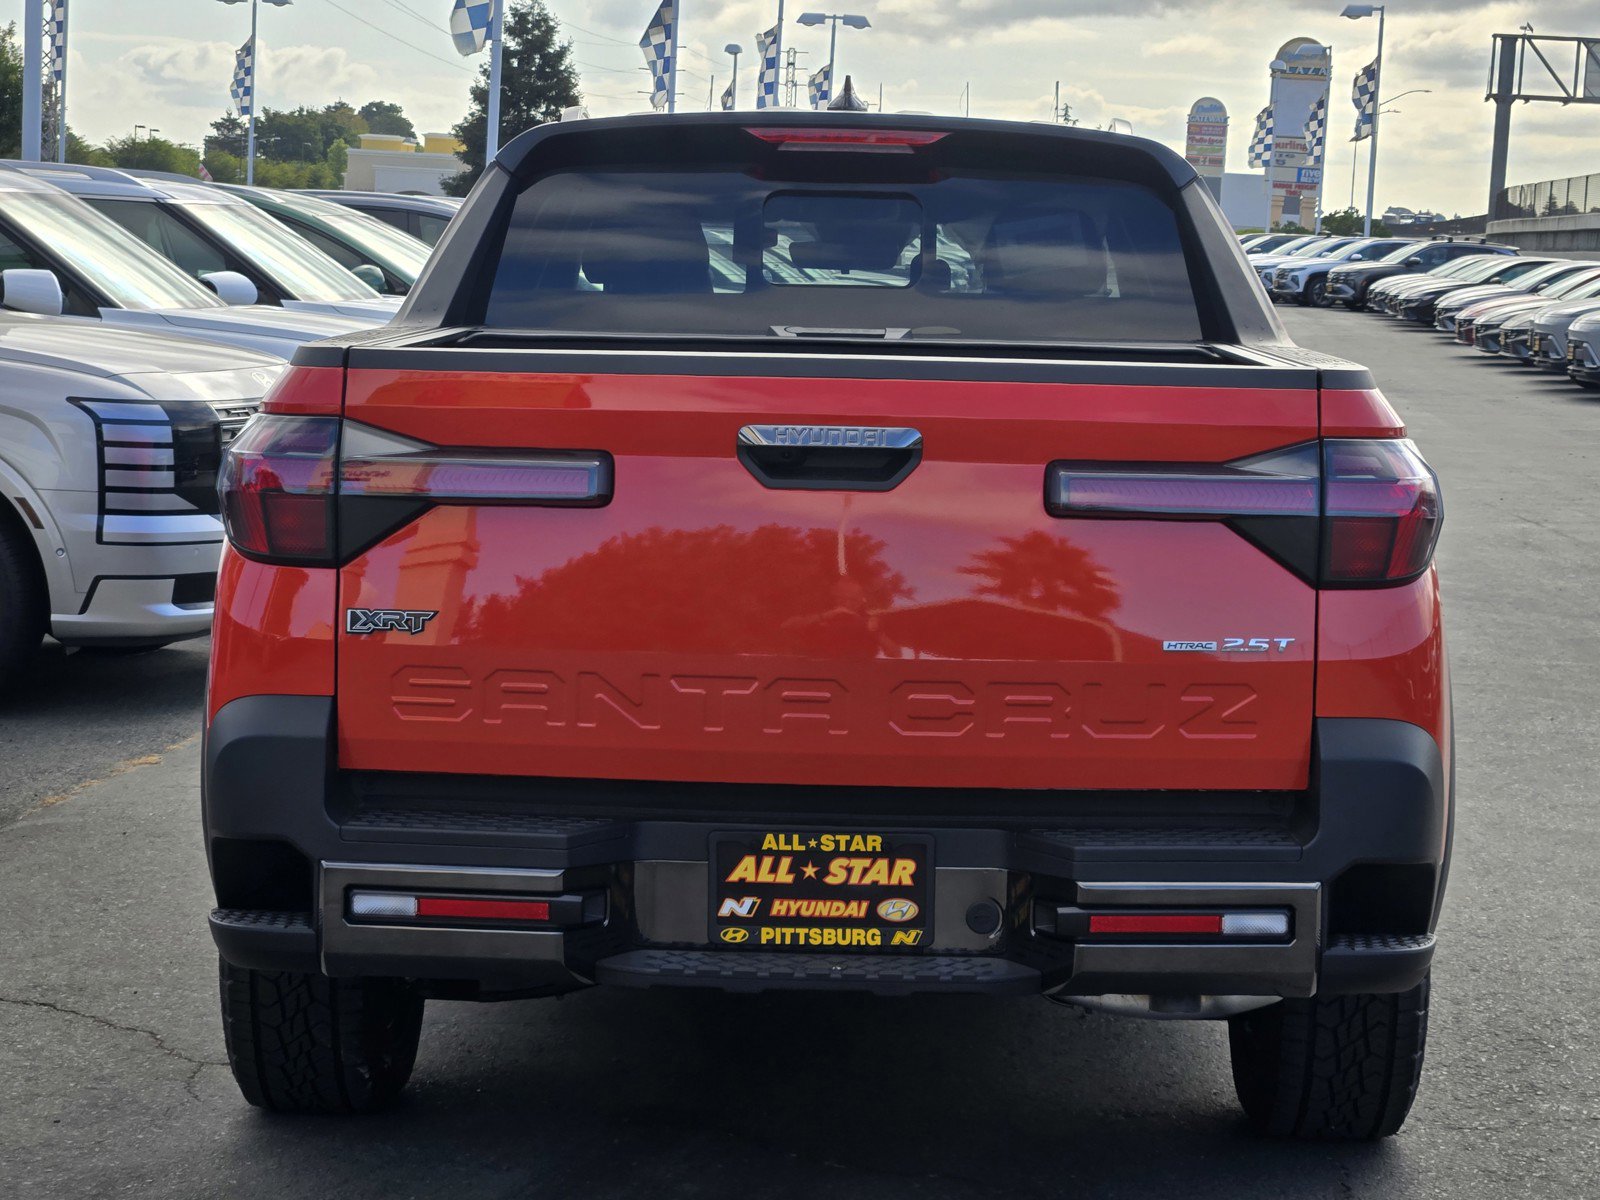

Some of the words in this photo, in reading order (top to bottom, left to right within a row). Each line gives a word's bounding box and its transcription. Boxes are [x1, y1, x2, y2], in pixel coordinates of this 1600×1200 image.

[1285, 66, 1327, 76] LAZA
[774, 427, 887, 446] HYUNDAI
[1165, 642, 1215, 651] HTRAC
[391, 665, 849, 736] SANTA
[889, 680, 1258, 740] CRUZ
[762, 833, 805, 851] ALL
[820, 834, 882, 852] STAR
[725, 855, 796, 884] ALL
[823, 857, 917, 886] STAR
[770, 898, 870, 918] HYUNDAI
[761, 928, 881, 946] PITTSBURG
